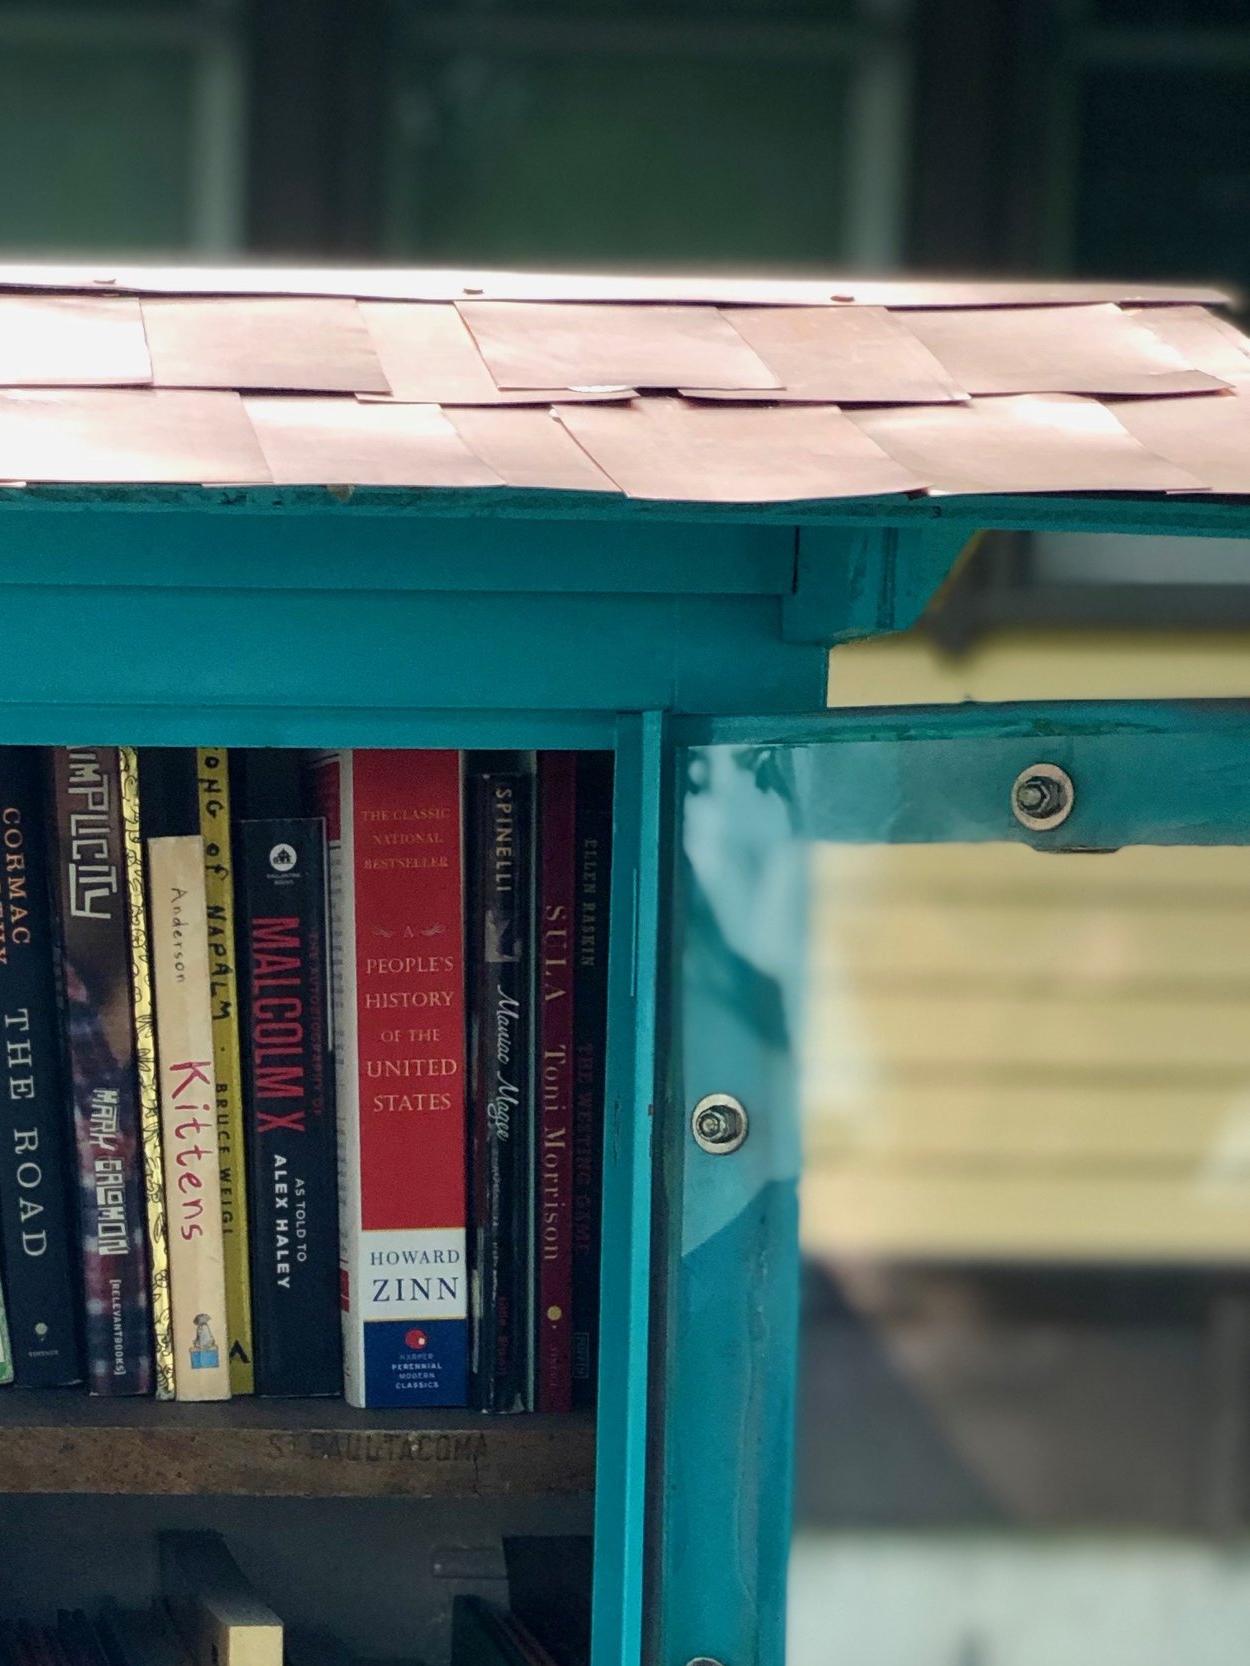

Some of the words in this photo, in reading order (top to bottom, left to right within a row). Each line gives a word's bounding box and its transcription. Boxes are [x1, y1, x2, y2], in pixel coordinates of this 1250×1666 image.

[198, 747, 224, 818] ONG
[206, 843, 229, 880] of
[495, 788, 512, 892] SPINELLI
[583, 840, 597, 893] ELLEN
[2, 808, 31, 944] CORMAC
[170, 888, 188, 983] Anderson
[206, 906, 235, 1020] NAPALM
[544, 905, 567, 1003] SULA
[581, 902, 596, 966] RASKIN
[367, 957, 454, 974] PEOPLE'S
[252, 917, 305, 1098] MALCOLM
[366, 991, 454, 1008] HISTORY
[4, 1009, 36, 1099] THE
[381, 1030, 401, 1042] OF
[409, 1029, 440, 1041] THE
[367, 1059, 457, 1077] UNITED
[543, 1045, 567, 1112] Toni
[255, 1112, 306, 1133] X
[374, 1093, 451, 1112] STATES
[170, 1062, 214, 1241] Kittens
[13, 1128, 47, 1257] ROAD
[274, 1155, 288, 1209] ALEX
[294, 1179, 305, 1196] AS
[543, 1126, 566, 1261] Morrison
[295, 1201, 306, 1238] TOLD
[275, 1219, 290, 1289] HALEY
[296, 1244, 307, 1262] TO
[371, 1249, 460, 1265] HOWARD
[373, 1277, 459, 1302] ZINN
